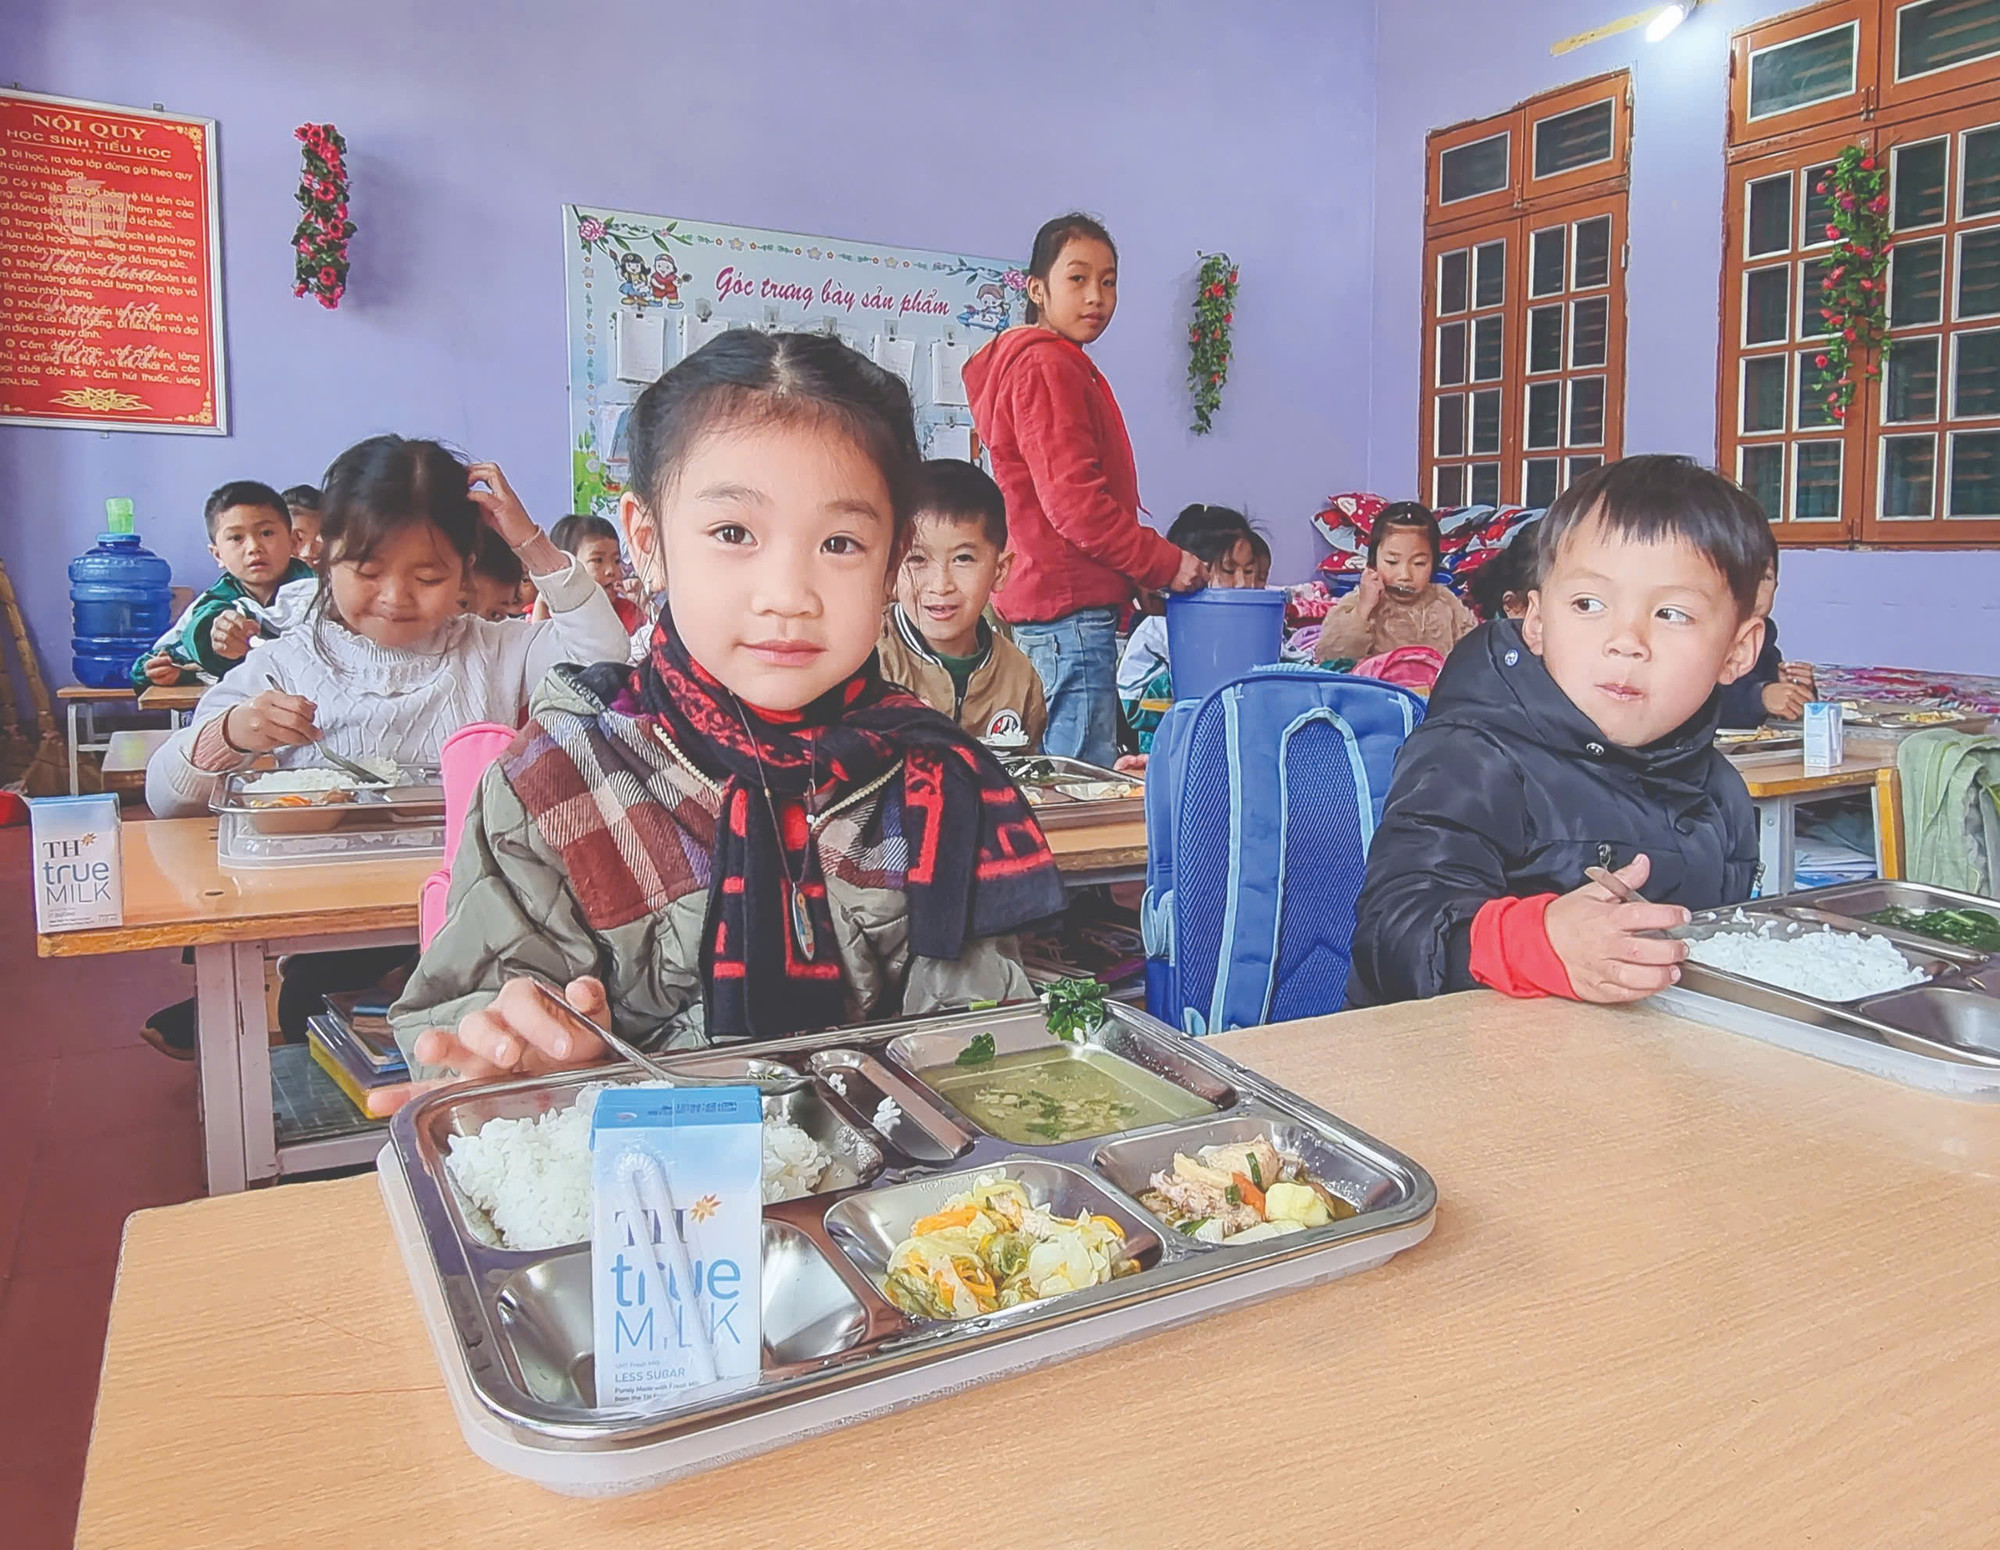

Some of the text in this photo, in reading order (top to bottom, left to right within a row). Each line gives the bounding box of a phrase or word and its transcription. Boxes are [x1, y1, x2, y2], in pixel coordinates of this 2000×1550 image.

[32, 113, 146, 141] NỘI QUY
[6, 129, 172, 159] HỌC SINH TIỂU HỌC
[174, 171, 193, 182] quy
[715, 266, 950, 318] Góc trưng bày sản phẩm
[57, 328, 76, 338] quy
[43, 839, 80, 859] TH
[43, 861, 109, 885] true
[47, 881, 111, 906] MILK
[615, 1367, 686, 1383] LESS SUGAR
